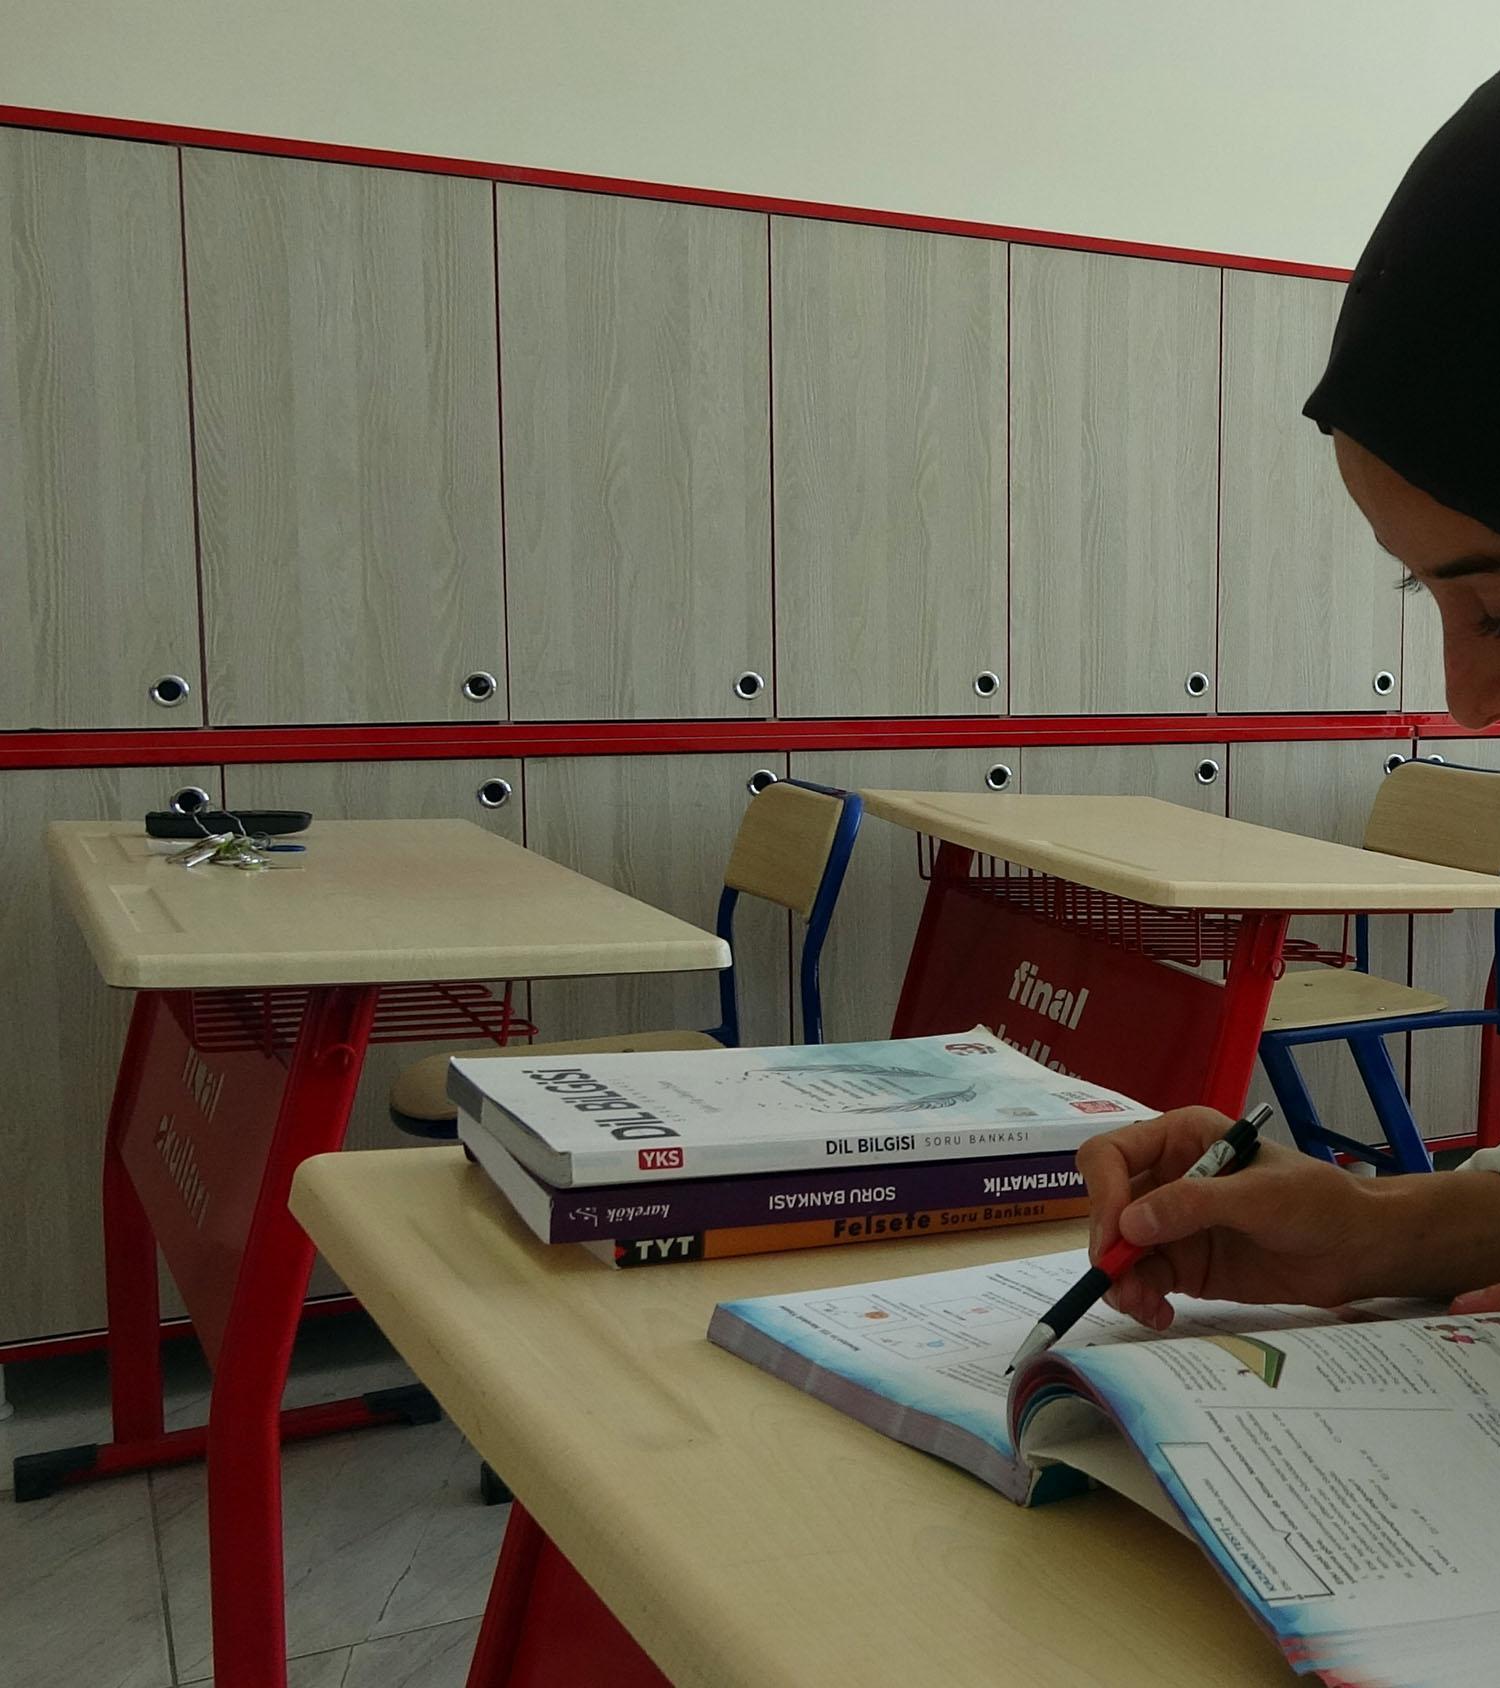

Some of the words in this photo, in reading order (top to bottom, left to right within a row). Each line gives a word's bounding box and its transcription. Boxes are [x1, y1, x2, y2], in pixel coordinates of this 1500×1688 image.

[1008, 960, 1090, 1031] final
[924, 1135, 962, 1148] SORU
[968, 1131, 1030, 1145] BANKASI
[642, 1150, 681, 1168] YKS
[983, 1171, 1084, 1197] MATEMATİK
[768, 1190, 846, 1211] BANKASI
[849, 1186, 897, 1204] SORU
[607, 1203, 671, 1223] karekök
[636, 1235, 695, 1261] TYT
[833, 1212, 931, 1238] Felsefe
[940, 1209, 978, 1226] Soru
[983, 1203, 1046, 1221] Bankası
